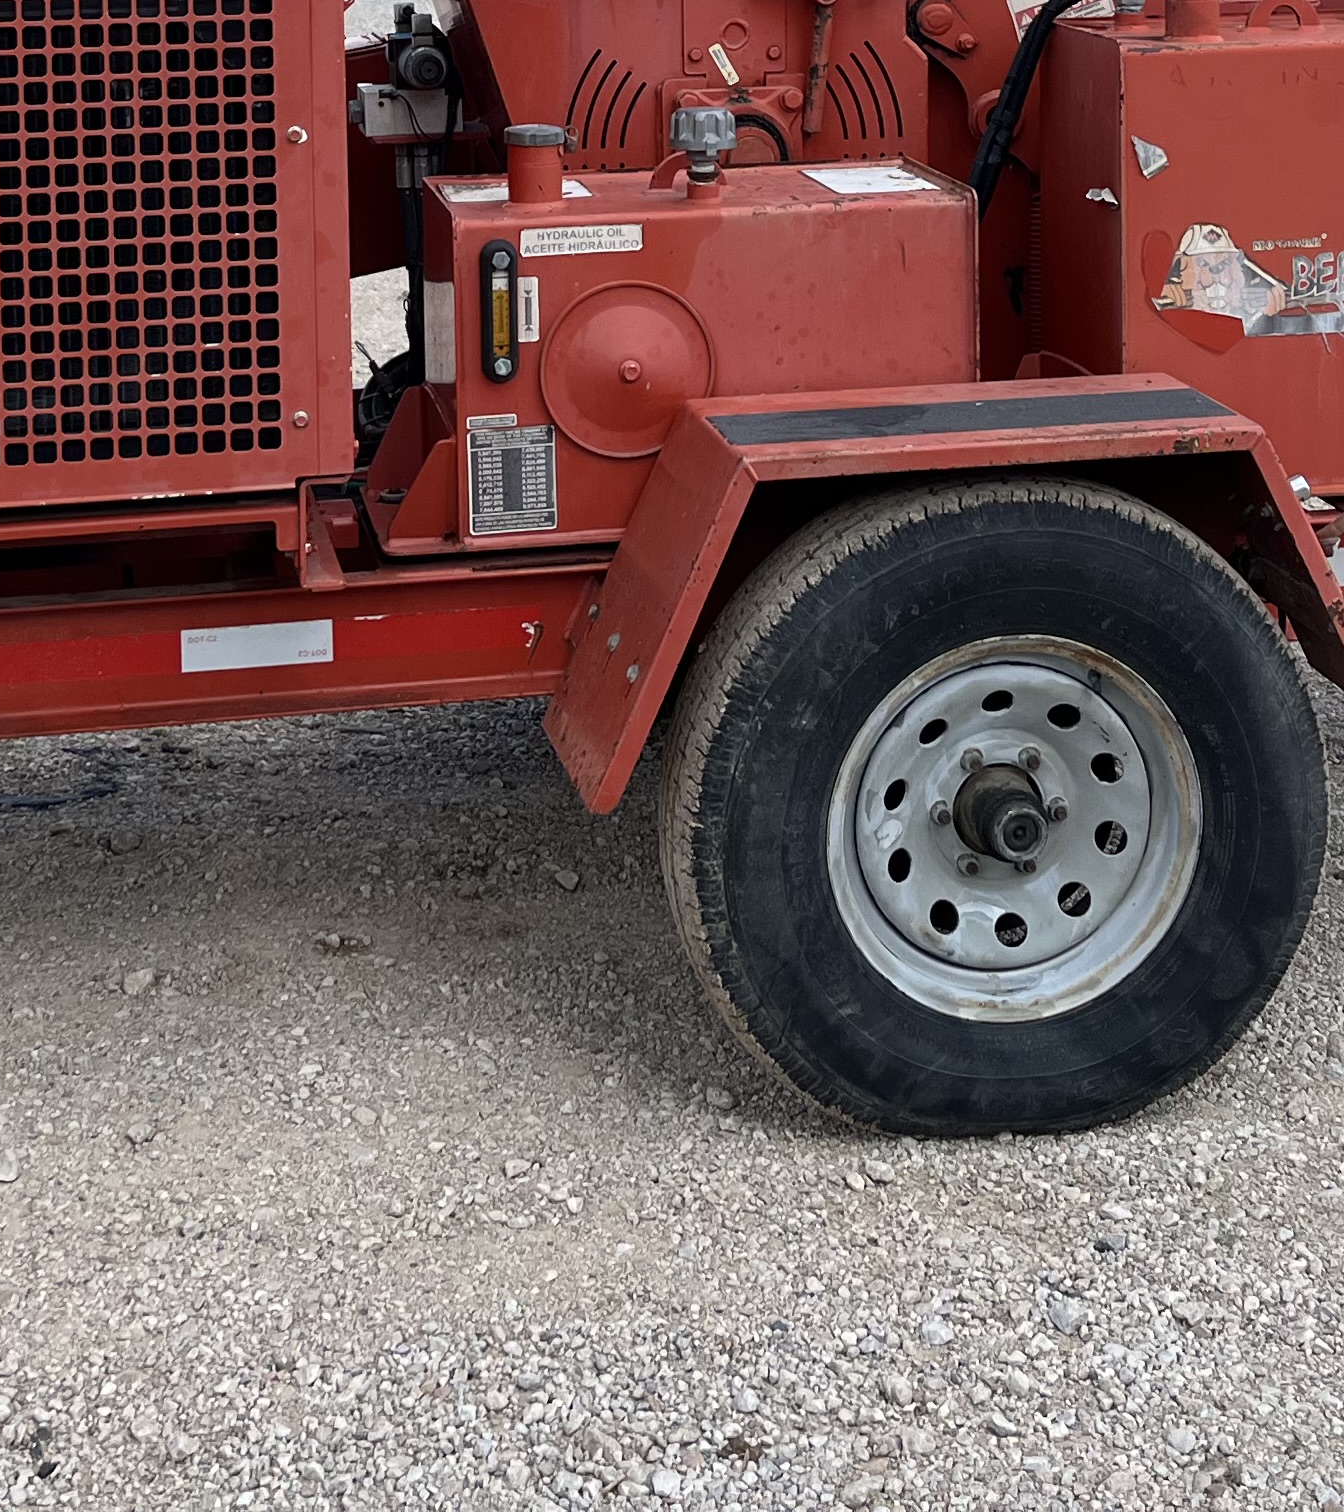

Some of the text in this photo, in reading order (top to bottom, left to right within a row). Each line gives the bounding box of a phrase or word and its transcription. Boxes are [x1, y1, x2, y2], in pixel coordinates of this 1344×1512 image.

[537, 227, 626, 241] HYDRAULIC OIL
[524, 241, 565, 255] ACEITE
